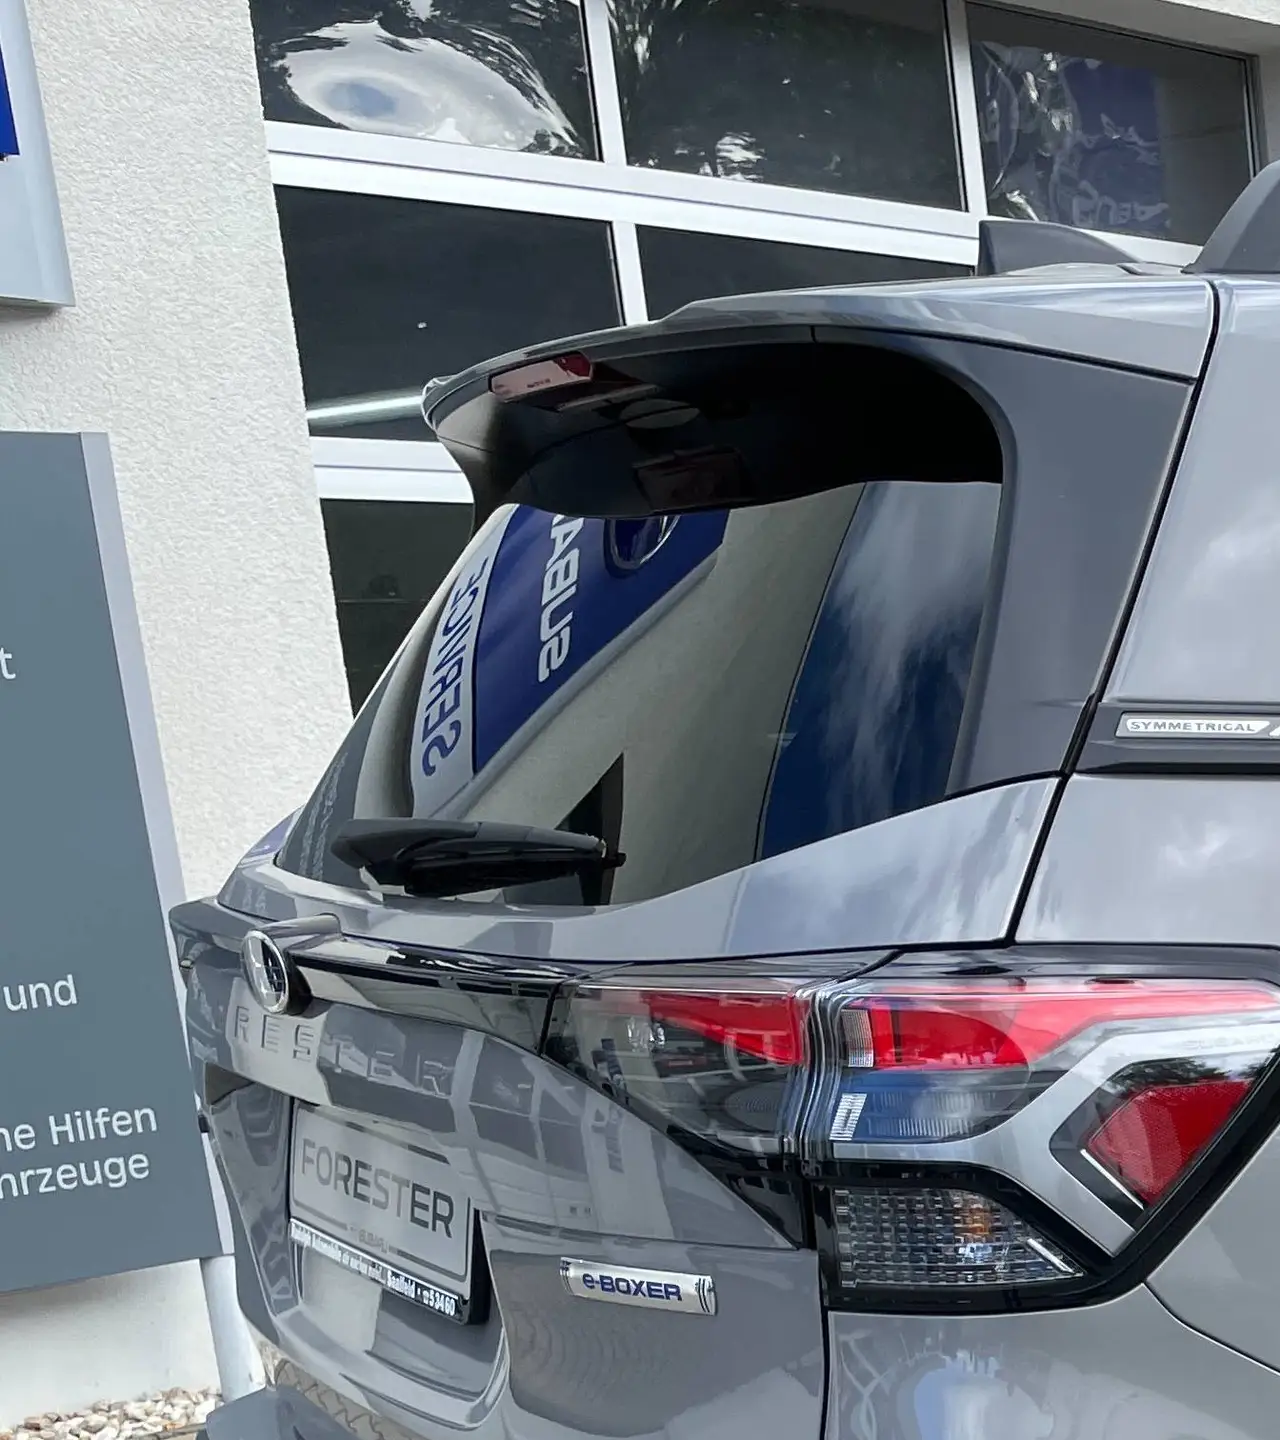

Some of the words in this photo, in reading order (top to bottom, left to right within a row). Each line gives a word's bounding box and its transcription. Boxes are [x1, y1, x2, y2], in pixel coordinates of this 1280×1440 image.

[1129, 720, 1256, 733] SYMMETRICAL
[3, 974, 77, 1012] und
[49, 1107, 157, 1145] Hilfen
[302, 1138, 452, 1239] FORESTER
[582, 1273, 682, 1301] e-BOXER
